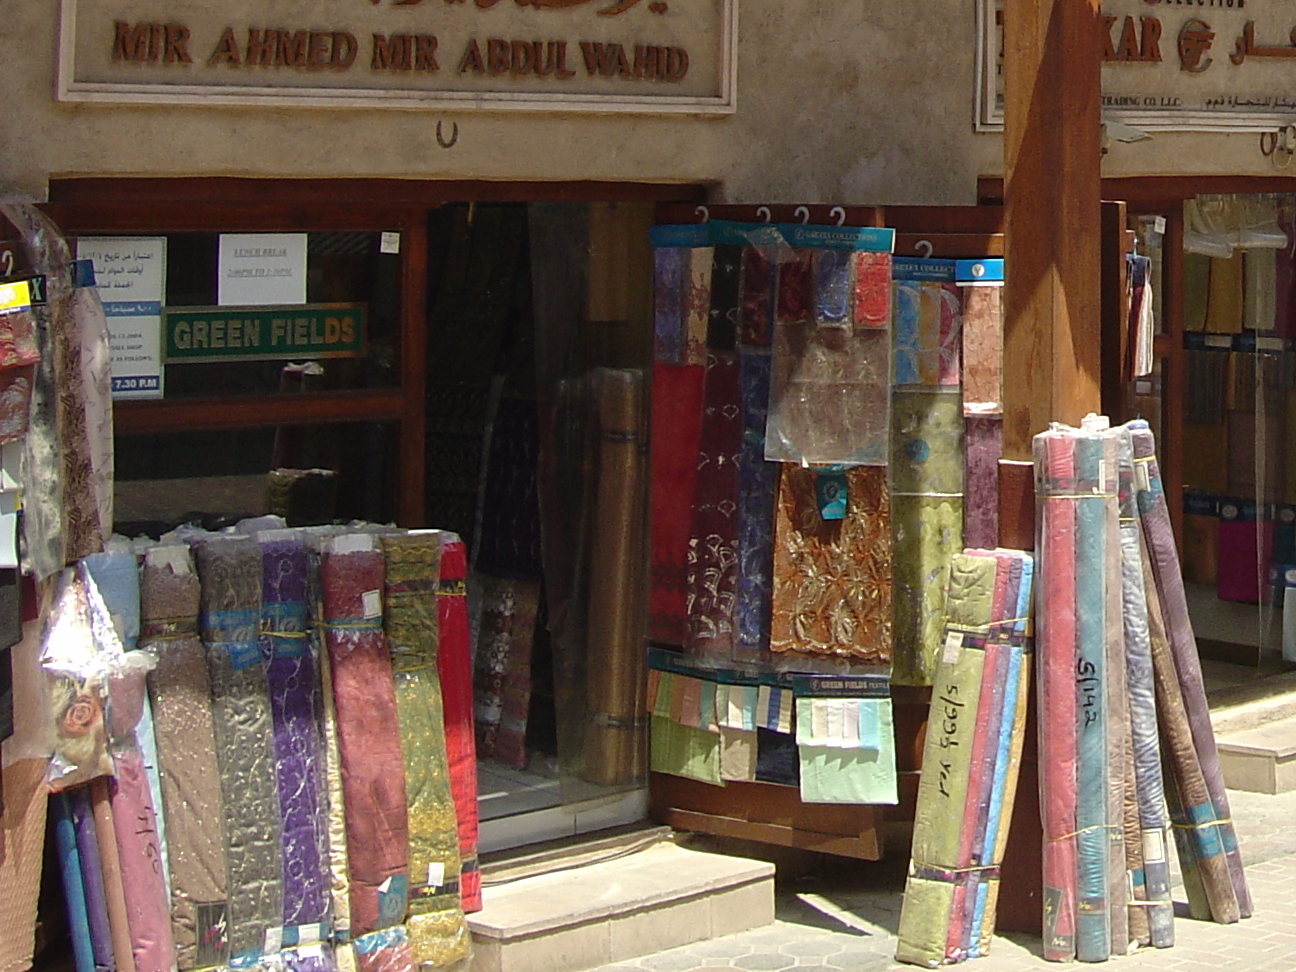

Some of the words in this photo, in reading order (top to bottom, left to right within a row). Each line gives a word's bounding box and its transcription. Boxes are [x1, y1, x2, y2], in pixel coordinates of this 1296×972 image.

[111, 22, 193, 65] MIR
[207, 27, 358, 71] AHMED
[371, 33, 440, 74] MIR
[457, 38, 577, 80] ABDUL
[579, 42, 691, 84] WAHID
[173, 318, 260, 350] GREEN
[270, 315, 355, 346] FIELDS
